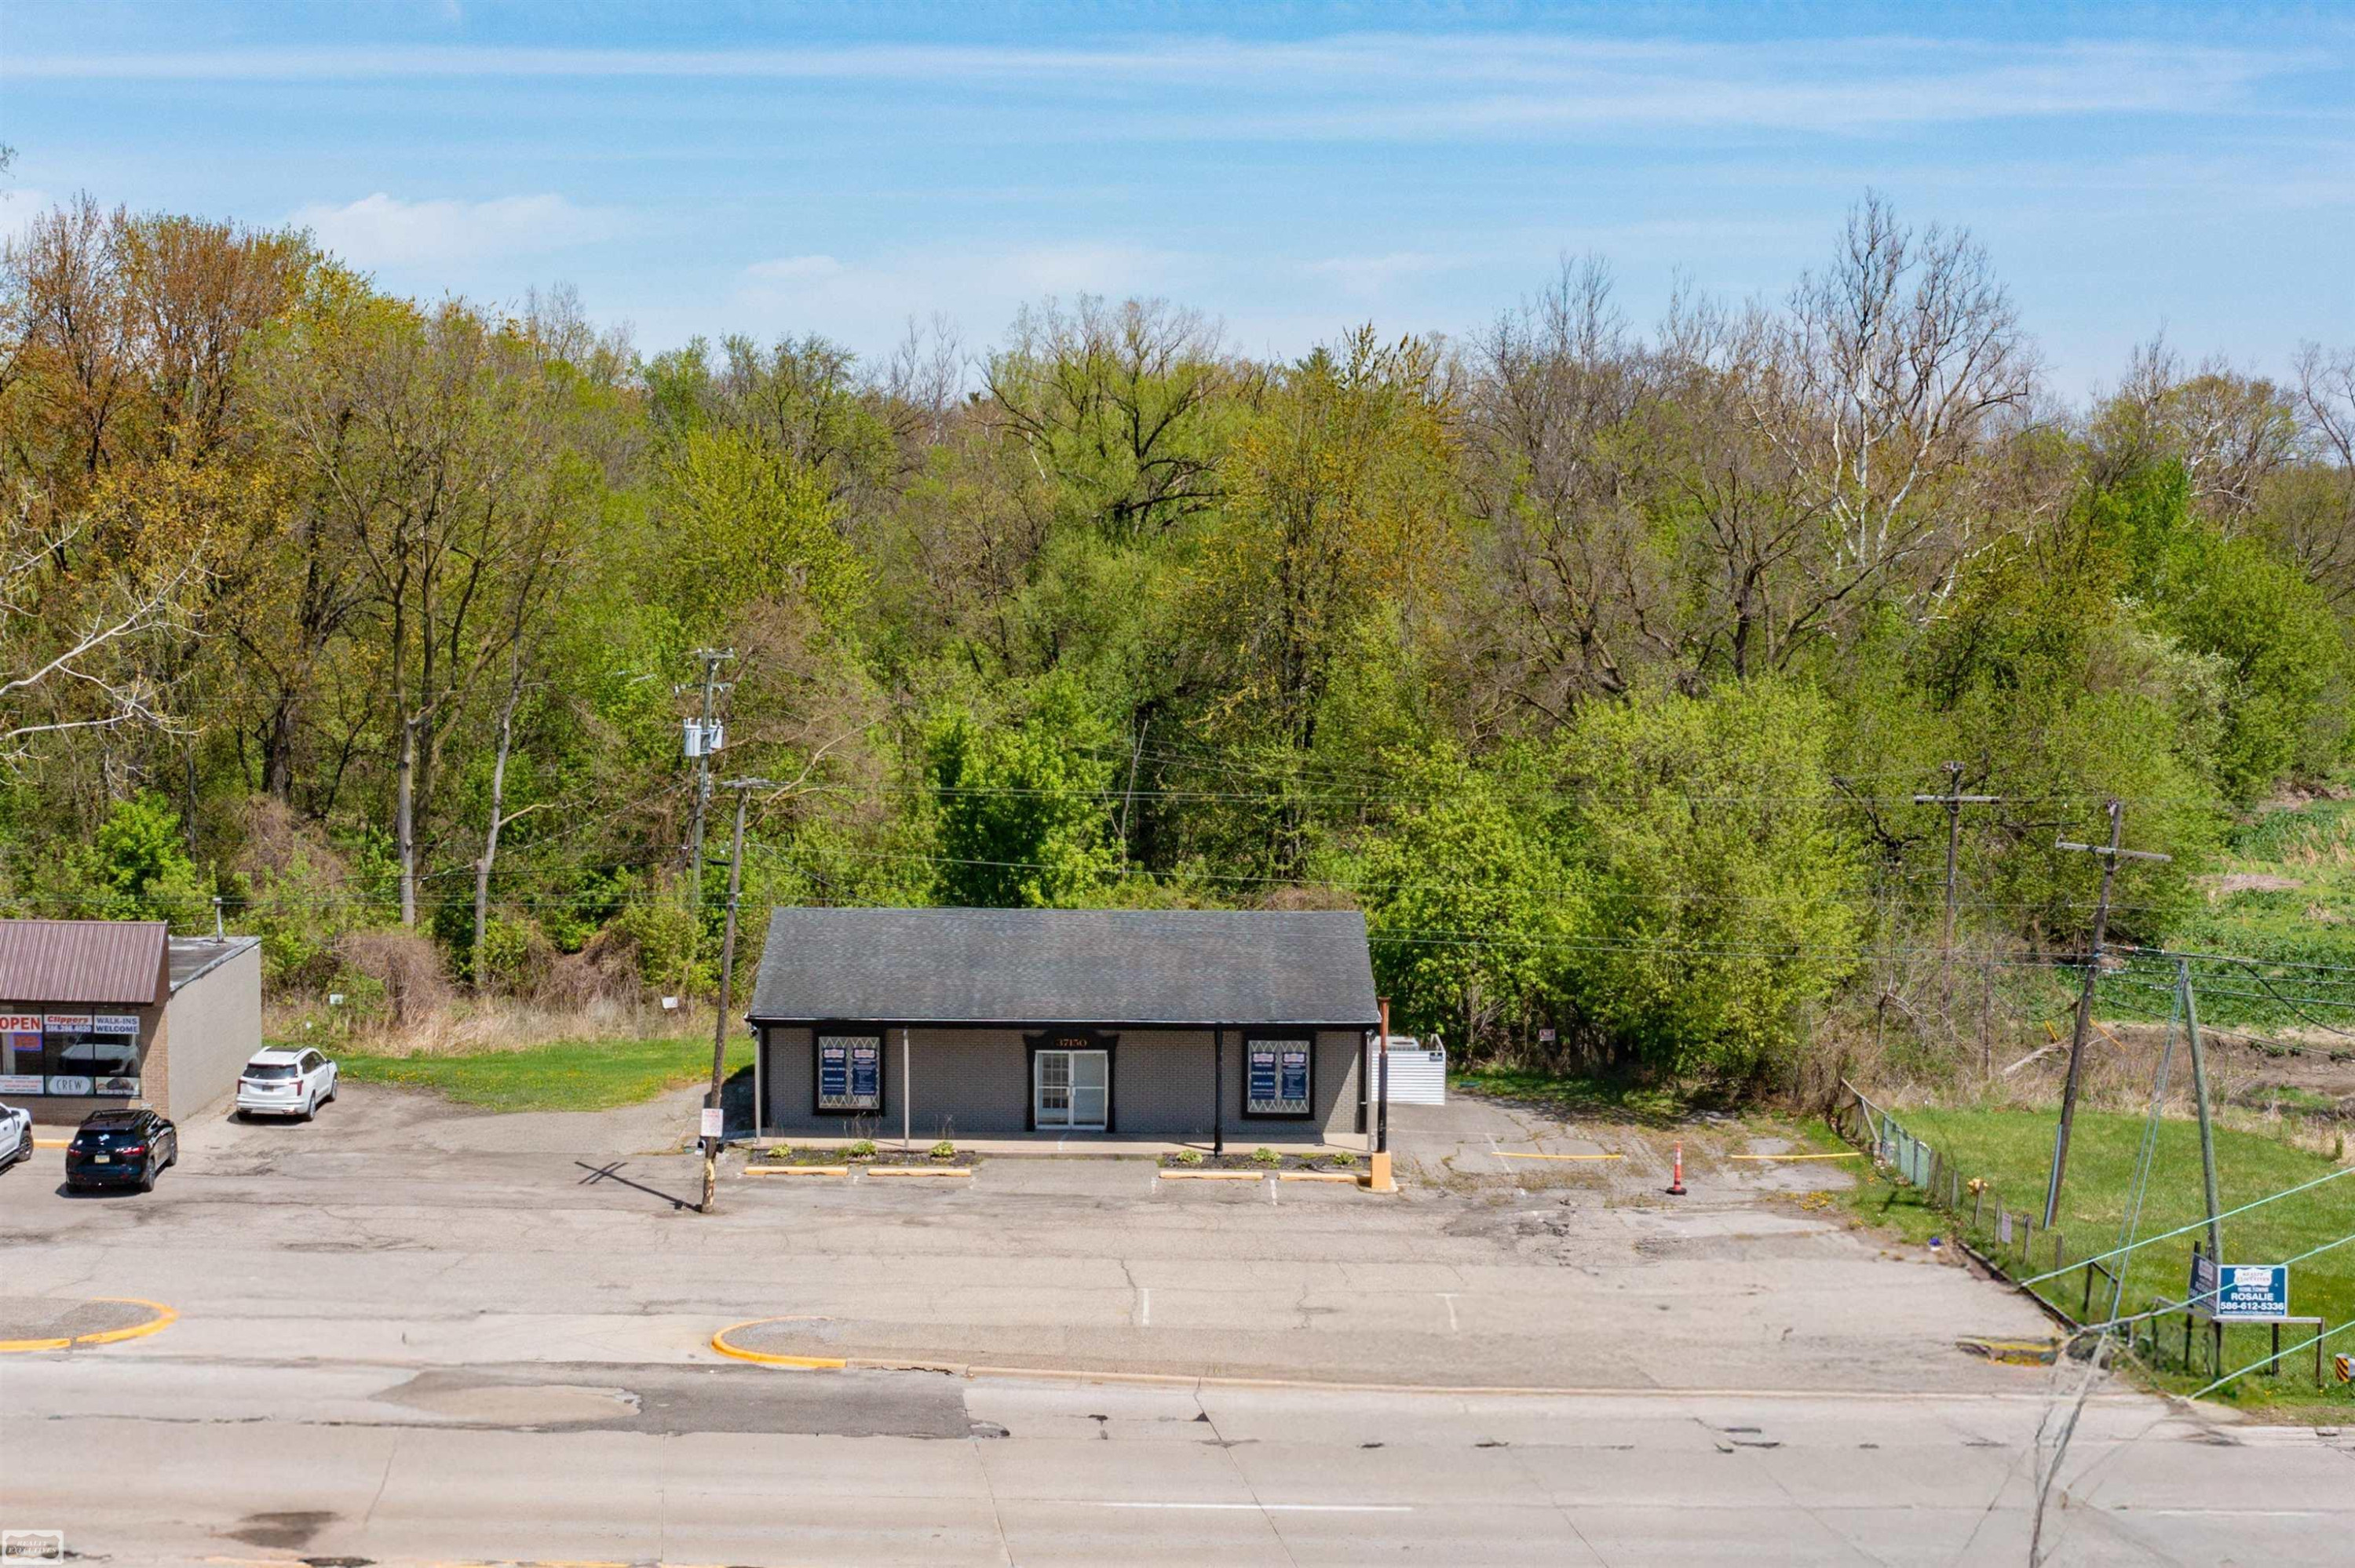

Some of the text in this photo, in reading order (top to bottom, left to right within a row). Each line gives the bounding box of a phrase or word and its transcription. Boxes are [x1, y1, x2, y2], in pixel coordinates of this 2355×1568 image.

[0, 1017, 41, 1030] OPEN
[48, 1016, 89, 1025] Clippers
[56, 1080, 82, 1090] CREW
[2231, 1293, 2274, 1301] ROSALIE
[2220, 1302, 2284, 1311] 586-612-5336
